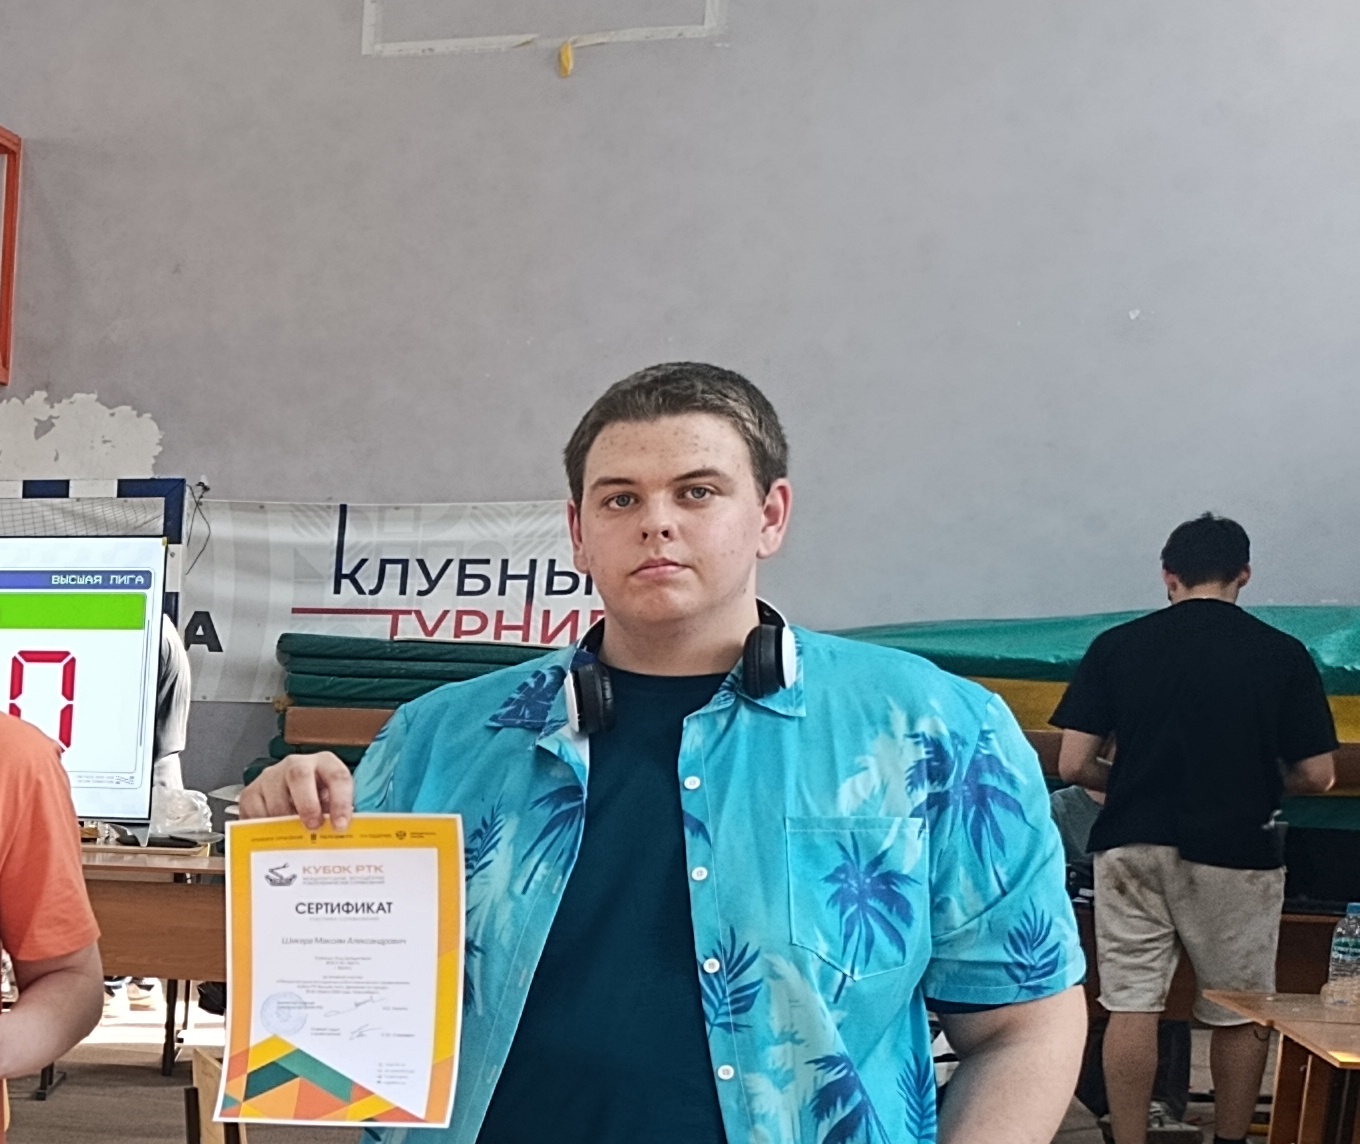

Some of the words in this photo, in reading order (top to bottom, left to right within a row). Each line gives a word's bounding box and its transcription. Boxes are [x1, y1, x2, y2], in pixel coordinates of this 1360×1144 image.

[333, 504, 593, 598] КЛУБНЫ
[51, 574, 102, 585] ВЫСШАЯ
[109, 574, 145, 585] ЛИГА
[383, 607, 605, 645] ТУРНИ
[302, 864, 353, 875] КУБОК
[356, 863, 385, 874] РТК
[295, 901, 393, 916] СЕРТИФИКАТ
